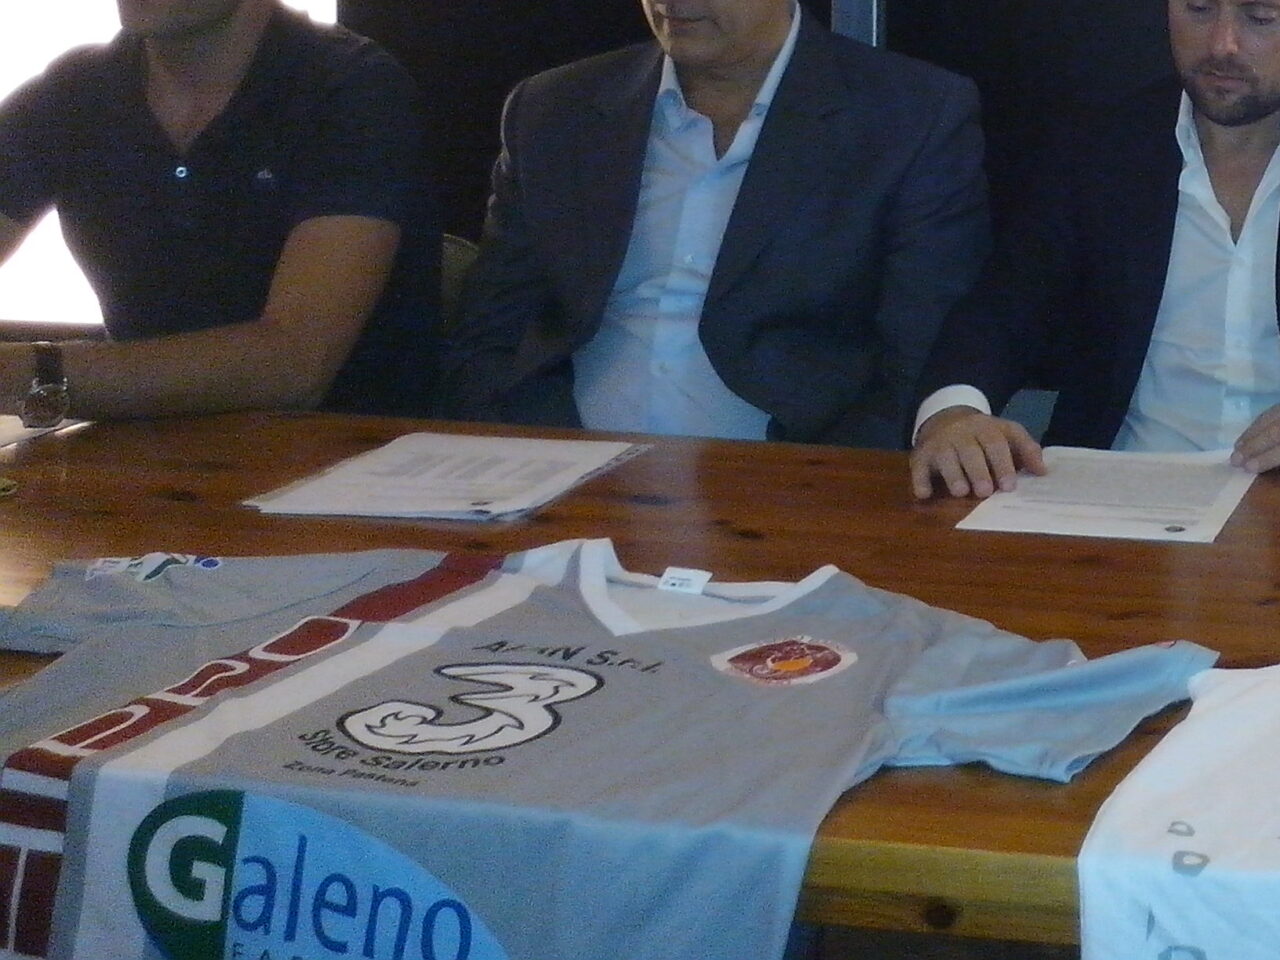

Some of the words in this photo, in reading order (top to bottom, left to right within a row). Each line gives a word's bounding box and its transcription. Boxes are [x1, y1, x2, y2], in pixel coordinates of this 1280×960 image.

[299, 728, 360, 761] Store
[360, 754, 506, 772] Salerno
[145, 814, 473, 960] Galeno
